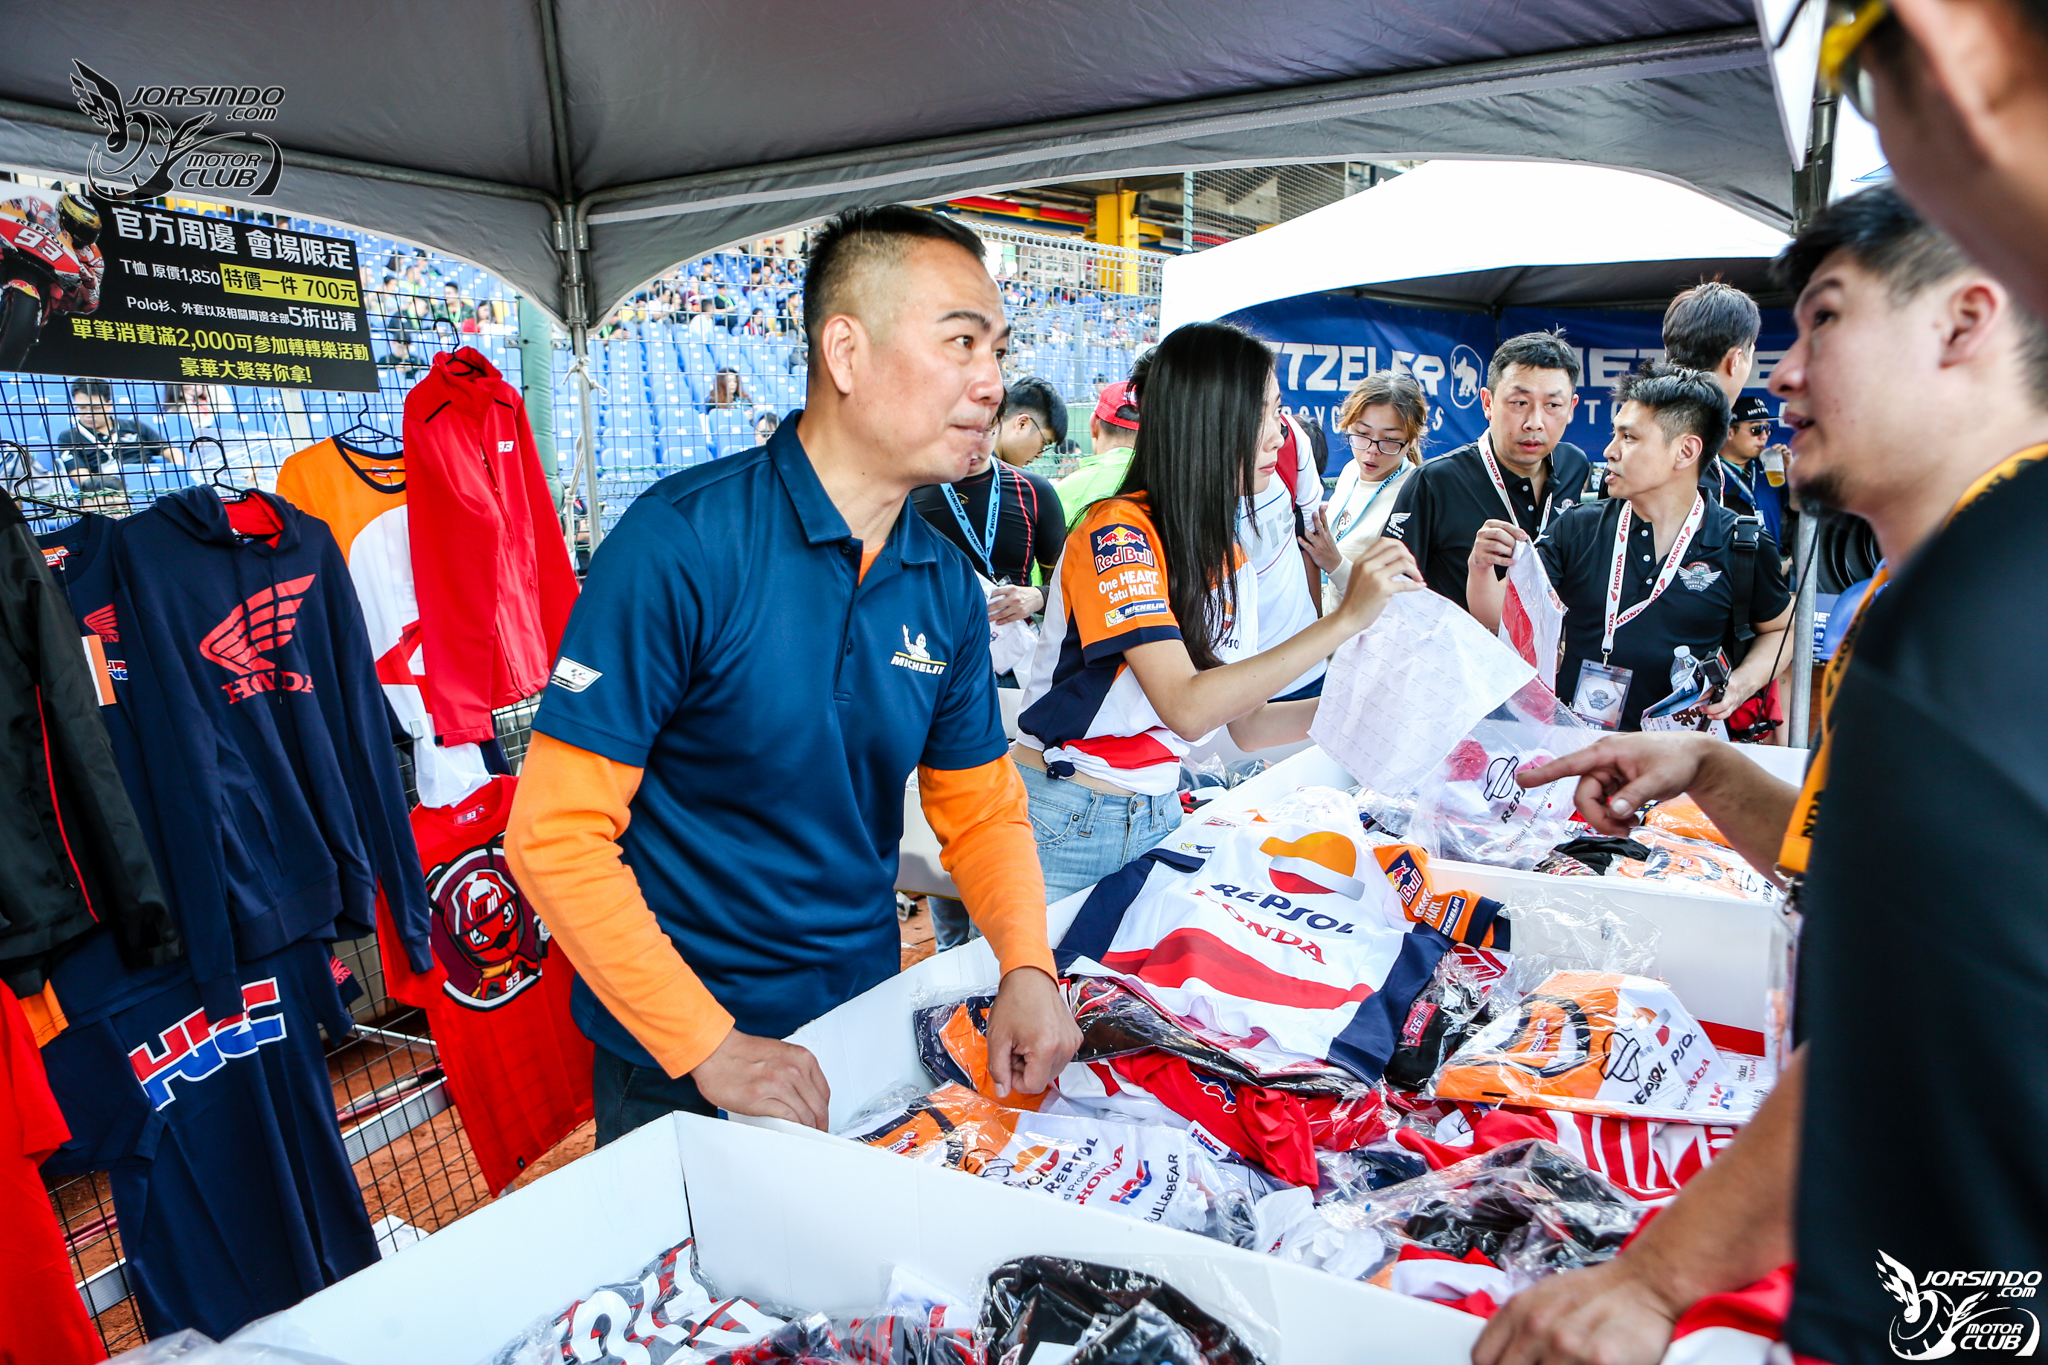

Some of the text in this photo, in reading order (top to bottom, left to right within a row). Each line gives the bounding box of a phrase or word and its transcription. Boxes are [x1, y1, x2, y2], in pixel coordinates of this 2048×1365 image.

[13, 227, 64, 262] 93
[111, 206, 353, 271] 官方周邊 會場限定
[497, 440, 514, 453] 93
[1485, 450, 1501, 481] HONDA
[947, 487, 963, 513] HONDA
[1095, 546, 1154, 573] Red Bull
[1666, 536, 1686, 569] HONDA
[1098, 570, 1159, 594] One HEART.
[1613, 553, 1623, 590] HONDA
[1108, 583, 1157, 604] Satu HATI.
[1124, 602, 1165, 615] MICHELIN
[466, 810, 477, 820] 93
[1506, 828, 1527, 852] Official
[1526, 796, 1548, 829] Licensed
[1400, 868, 1423, 906] Bull
[1210, 884, 1356, 934] REPSOL
[505, 971, 521, 991] 93
[1190, 1128, 1223, 1156] HRC
[1067, 1161, 1099, 1193] Product
[1075, 1144, 1124, 1205] HONDA
